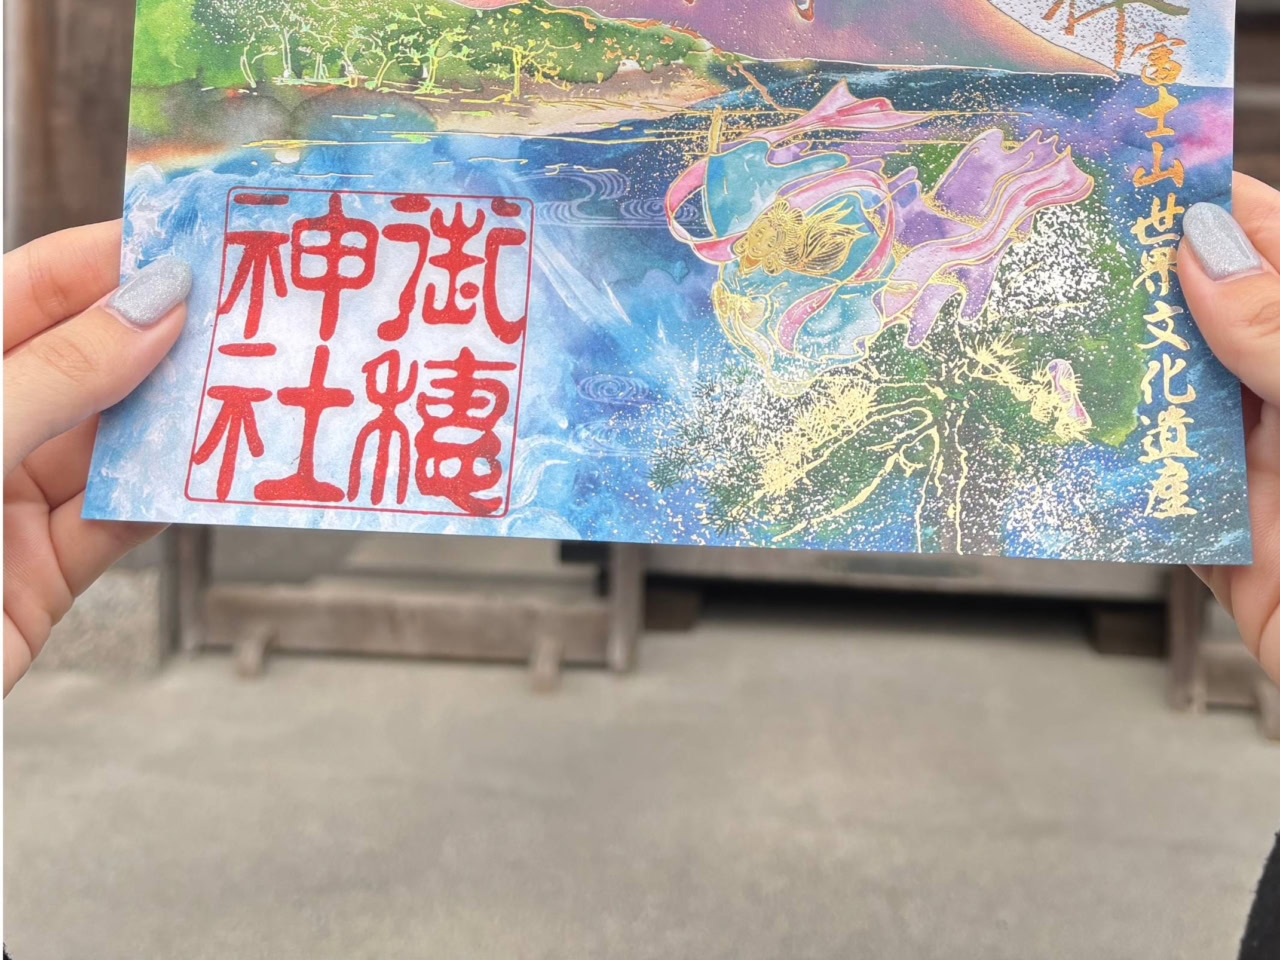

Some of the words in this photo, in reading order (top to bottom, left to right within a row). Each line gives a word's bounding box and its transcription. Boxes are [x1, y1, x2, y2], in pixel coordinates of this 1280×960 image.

[192, 192, 379, 503] 神社
[1128, 31, 1198, 520] 富士山世界文化遺産
